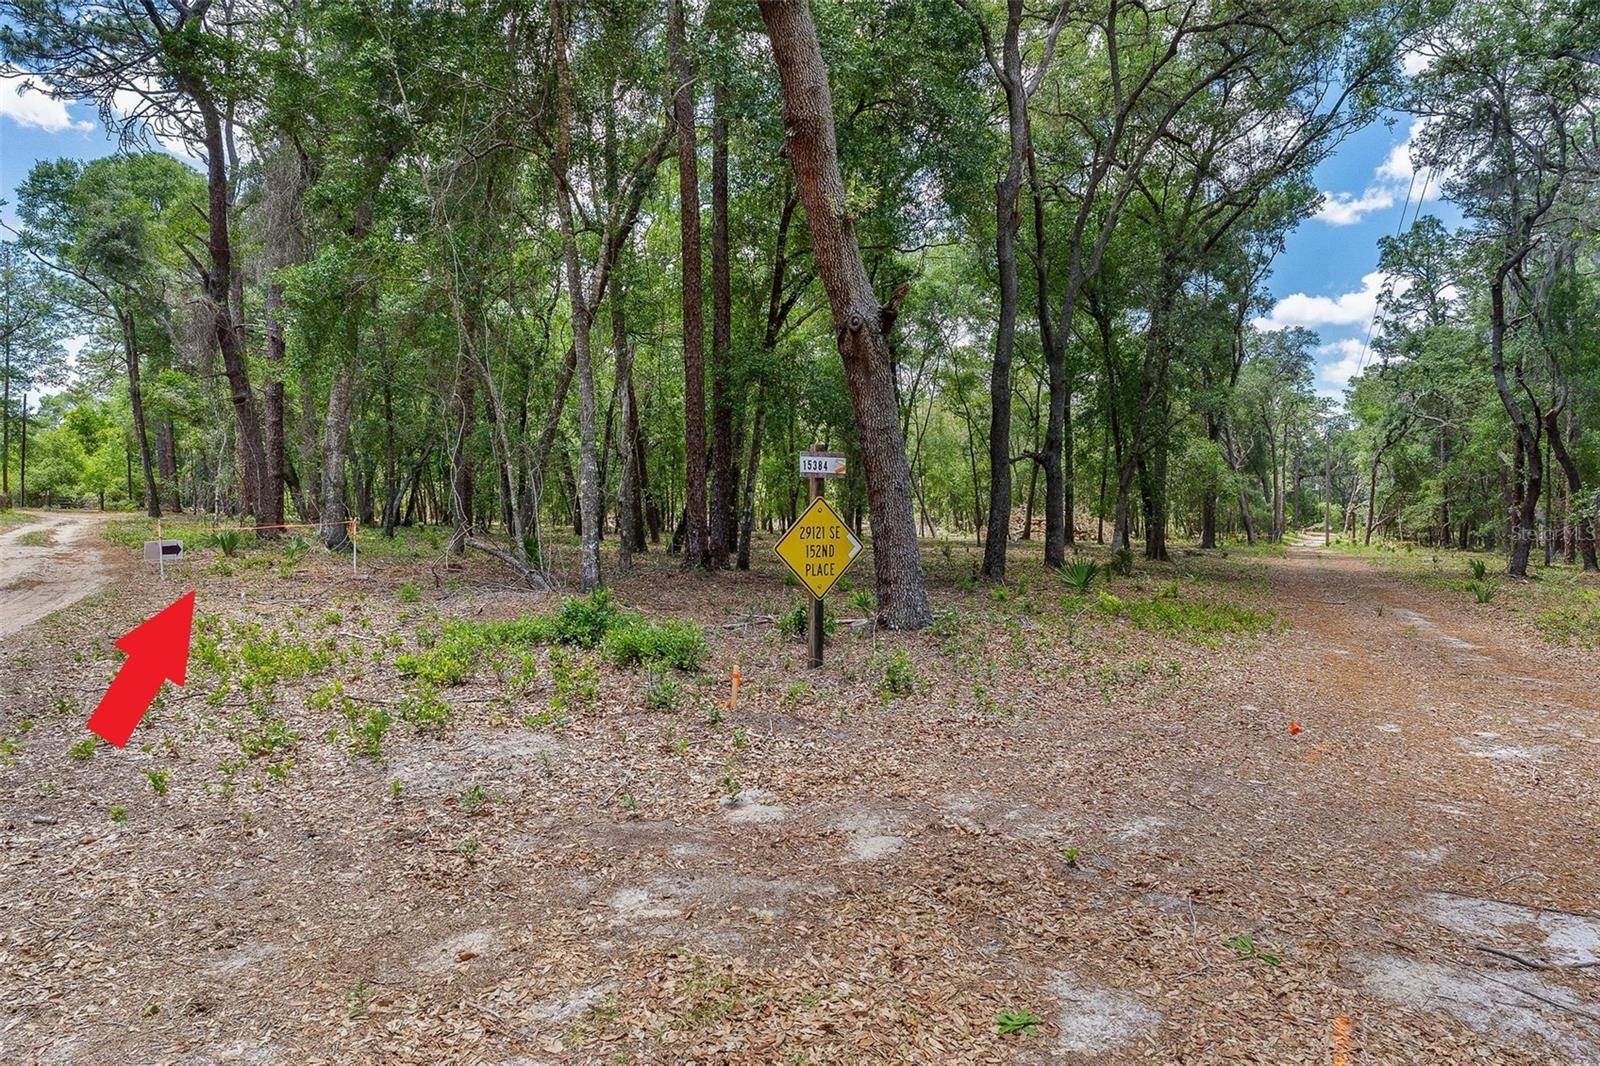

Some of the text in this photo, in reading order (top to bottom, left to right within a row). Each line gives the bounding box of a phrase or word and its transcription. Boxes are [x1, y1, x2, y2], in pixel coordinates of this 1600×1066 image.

[803, 460, 828, 471] 15384
[800, 526, 840, 539] 29121 SE
[805, 545, 835, 558] 152ND
[805, 563, 835, 576] PLACE
